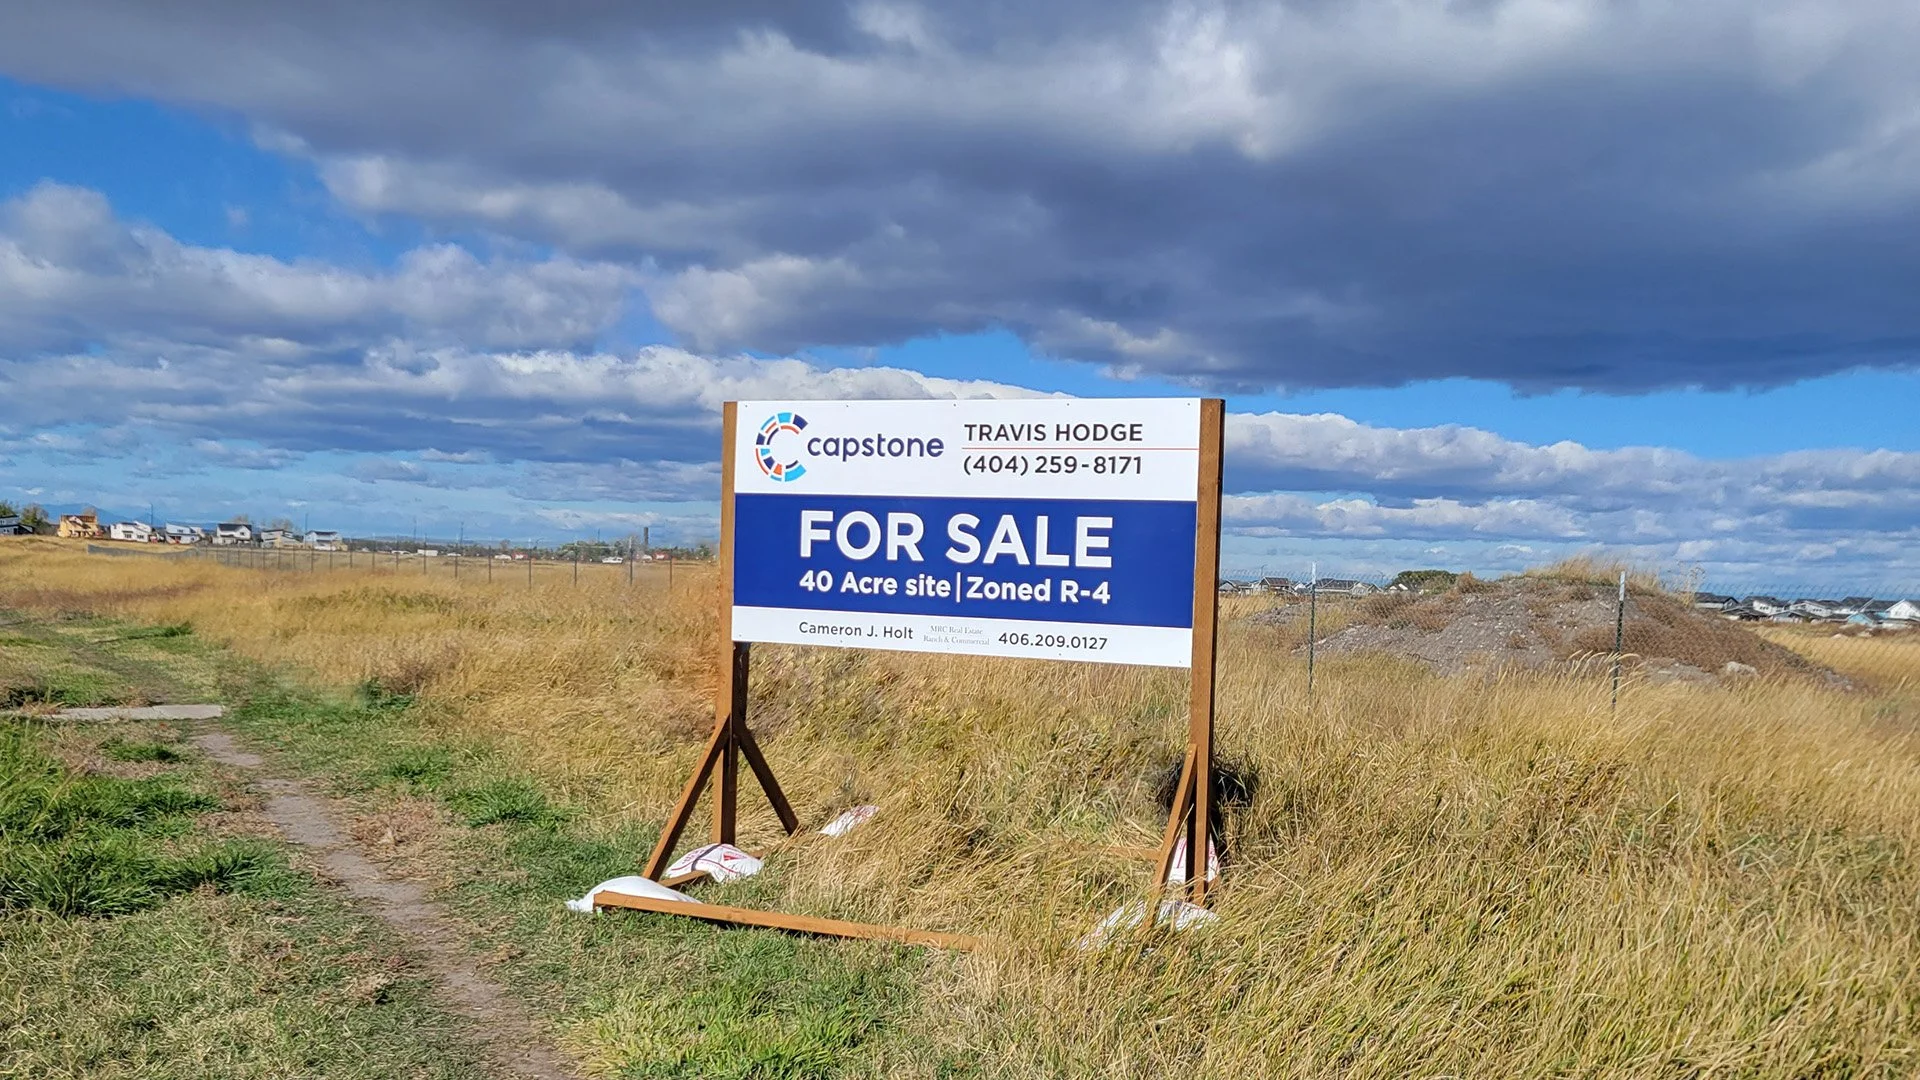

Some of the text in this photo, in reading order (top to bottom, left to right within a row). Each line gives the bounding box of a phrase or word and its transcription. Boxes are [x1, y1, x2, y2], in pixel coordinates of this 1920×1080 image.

[963, 423, 1143, 442] TRAVIS HODGE
[807, 433, 945, 463] capstone
[963, 455, 1142, 477] (404) 259-8171
[800, 509, 1113, 569] FOR SALE
[799, 569, 832, 593] 40
[840, 571, 898, 596] Acre
[905, 572, 951, 599] site
[966, 575, 1051, 603] Zoned
[1060, 579, 1111, 604] R-4
[799, 621, 914, 641] Cameron J. Holt
[998, 631, 1108, 651] 406.209.0127
